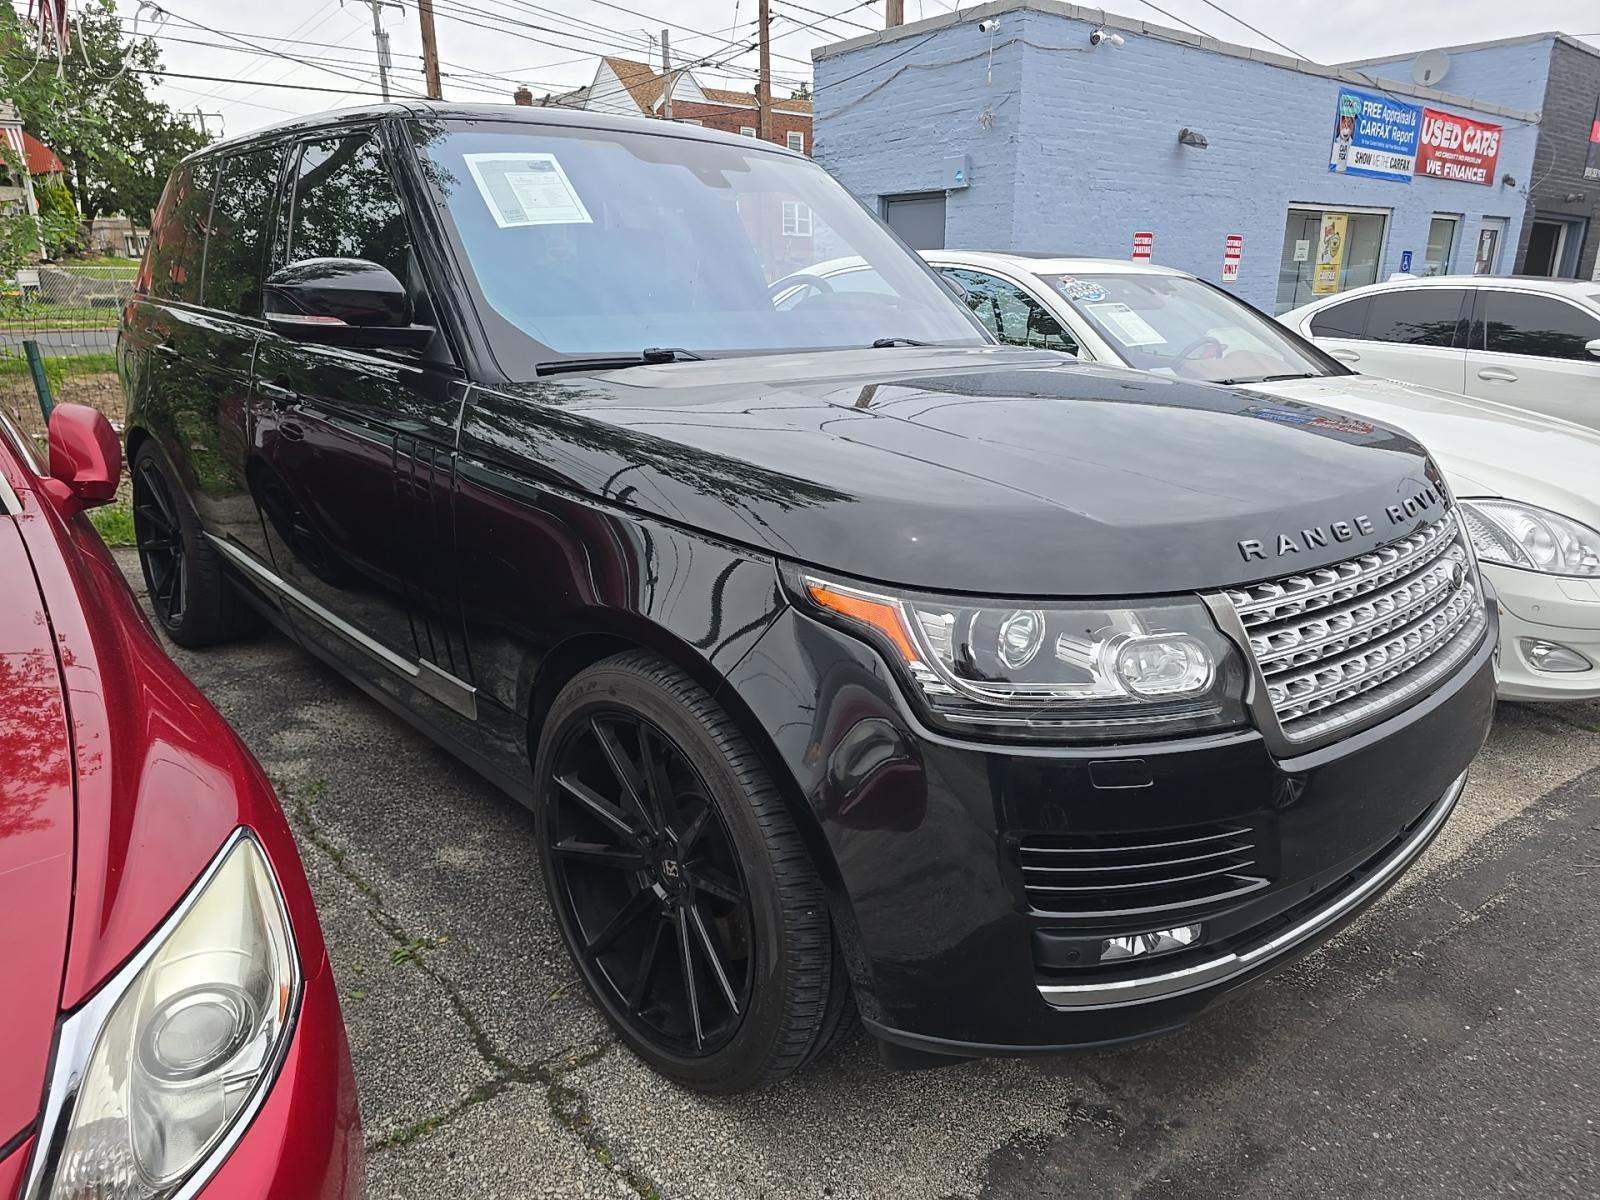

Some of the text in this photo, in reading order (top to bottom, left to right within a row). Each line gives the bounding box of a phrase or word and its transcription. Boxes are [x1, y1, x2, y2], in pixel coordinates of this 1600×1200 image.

[1362, 101, 1382, 118] FREE
[1382, 106, 1412, 125] Appraisal
[1410, 111, 1416, 126] &
[1359, 120, 1391, 140] CARFAX
[1391, 126, 1414, 145] Report
[1421, 117, 1462, 149] USED
[1463, 126, 1500, 157] CARS
[1355, 151, 1372, 165] SHOW
[1389, 157, 1411, 171] CARFAX
[1426, 159, 1487, 182] WE FINANCE!
[1133, 245, 1151, 254] PARKING
[1134, 237, 1152, 245] CUSTOMER
[1224, 264, 1237, 274] ONLY
[1237, 514, 1375, 562] RANGE
